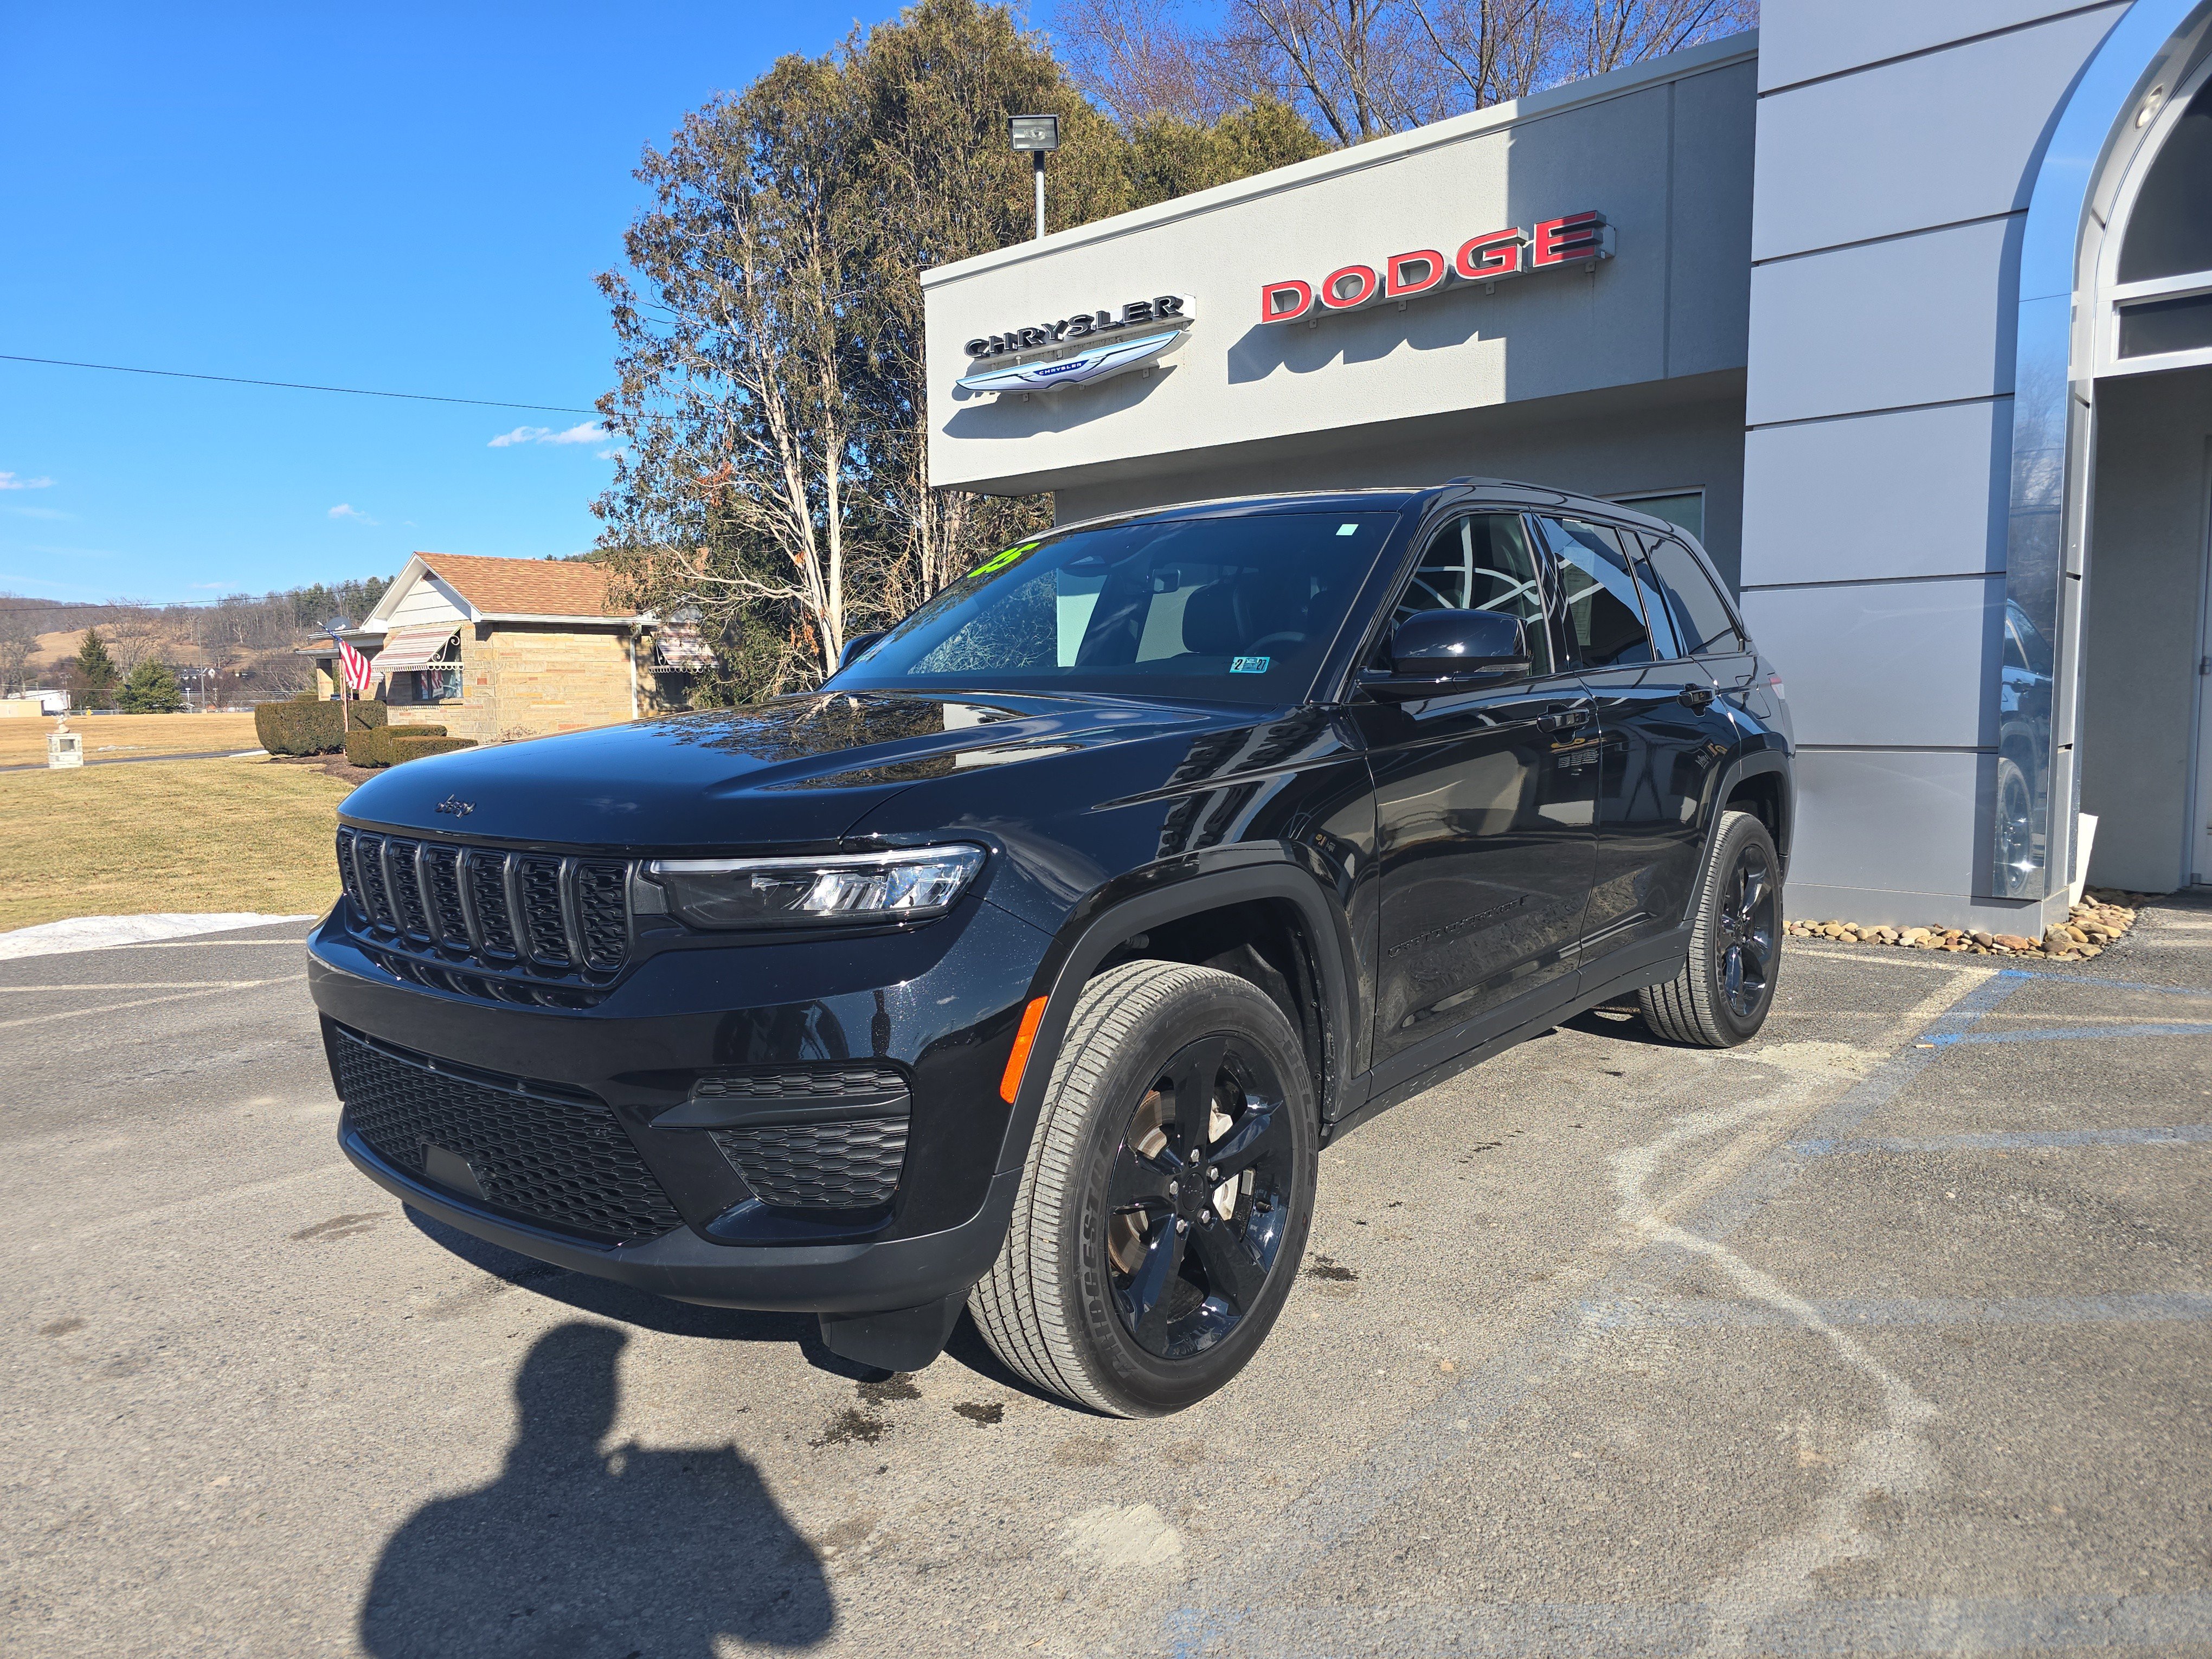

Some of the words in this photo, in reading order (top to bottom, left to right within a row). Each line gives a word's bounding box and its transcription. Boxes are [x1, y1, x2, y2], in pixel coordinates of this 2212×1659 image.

[1261, 210, 1606, 324] DODGE
[964, 295, 1184, 358] CHRYSLER
[1039, 363, 1082, 375] CHRYSLER
[1256, 659, 1267, 670] 27
